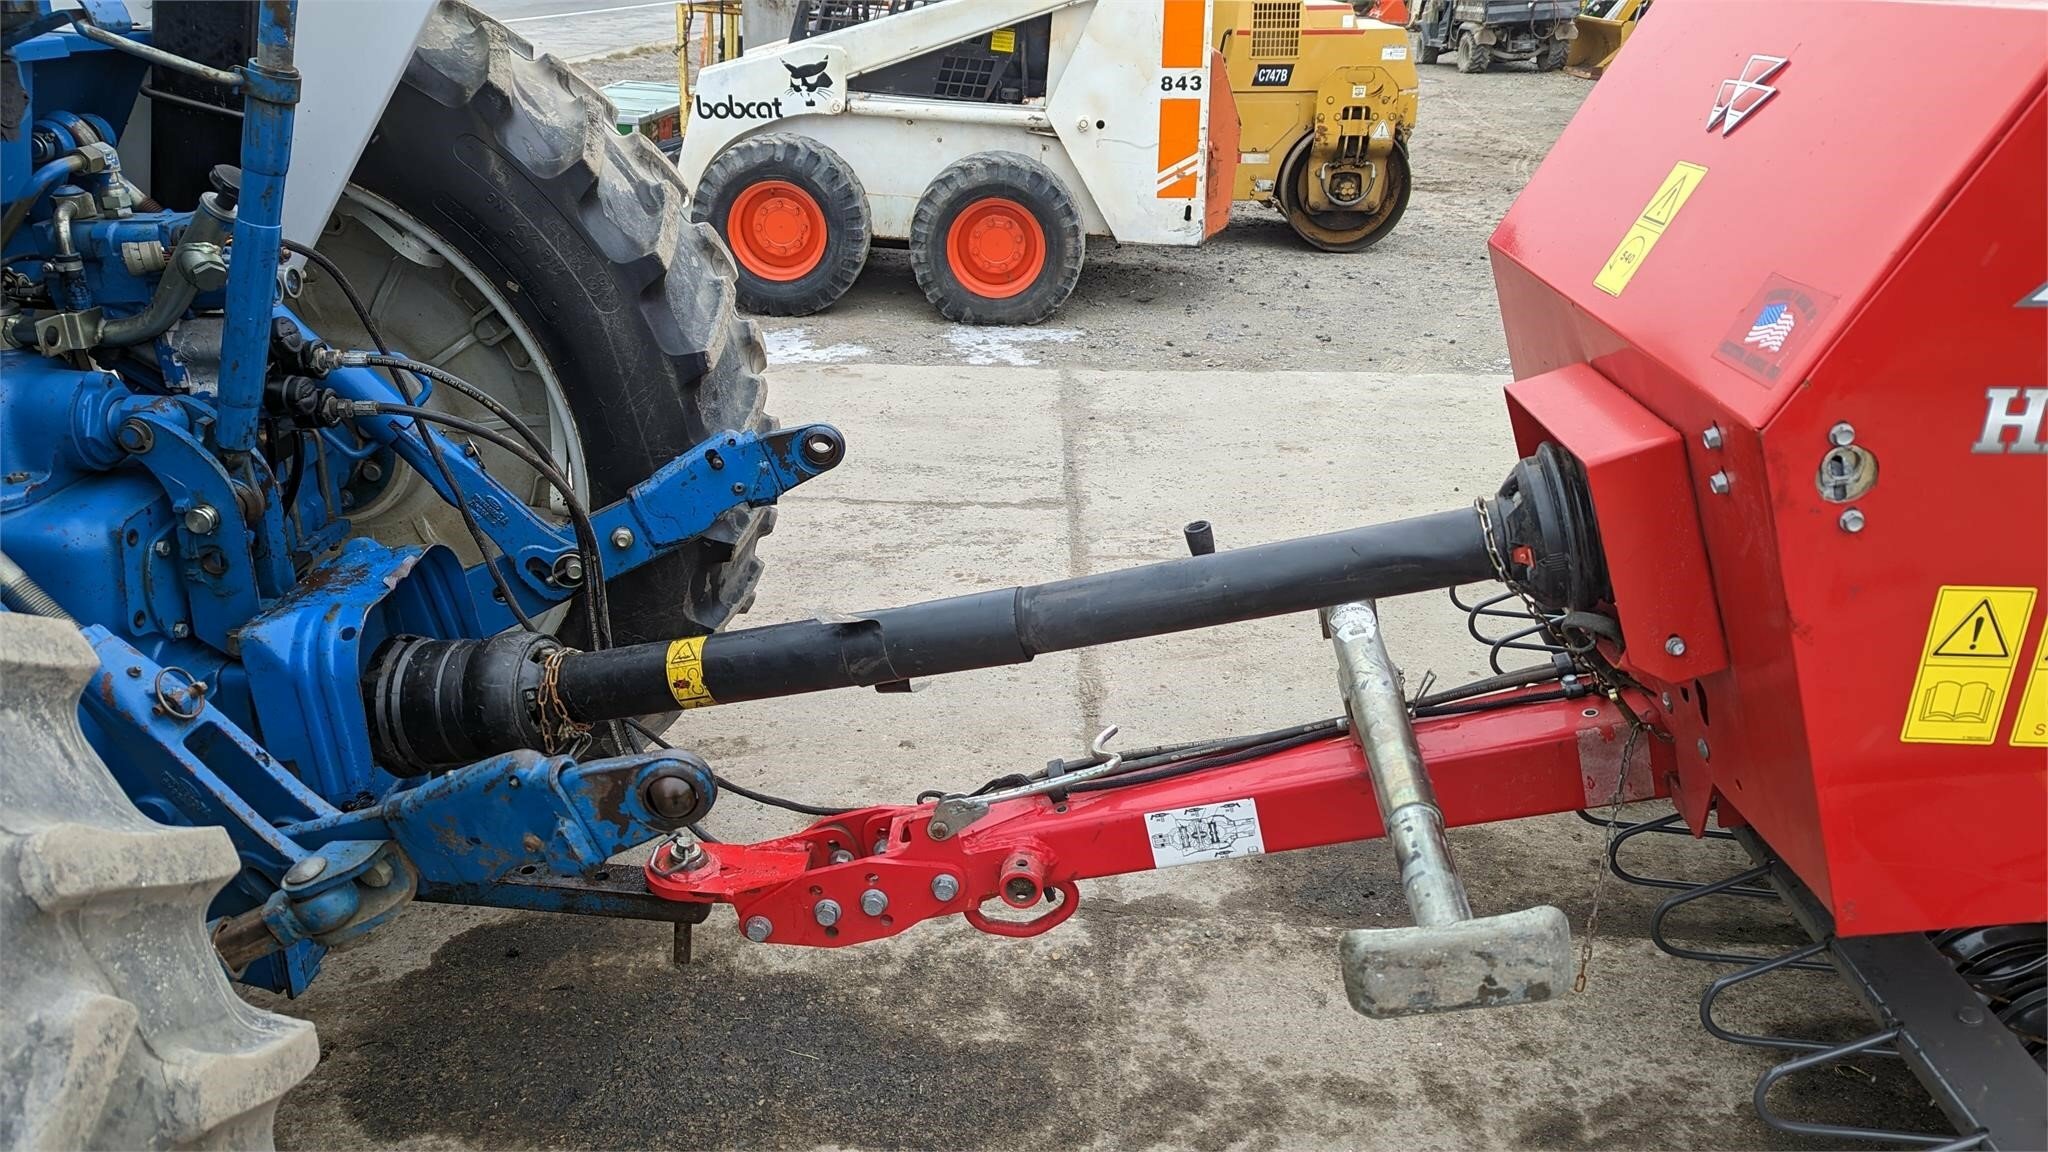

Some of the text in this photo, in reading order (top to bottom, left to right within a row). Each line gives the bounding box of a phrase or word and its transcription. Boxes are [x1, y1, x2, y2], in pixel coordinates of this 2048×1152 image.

[1160, 76, 1202, 91] 843
[1258, 68, 1289, 82] C747B
[695, 94, 784, 119] bobcat
[1971, 386, 2048, 455] H
